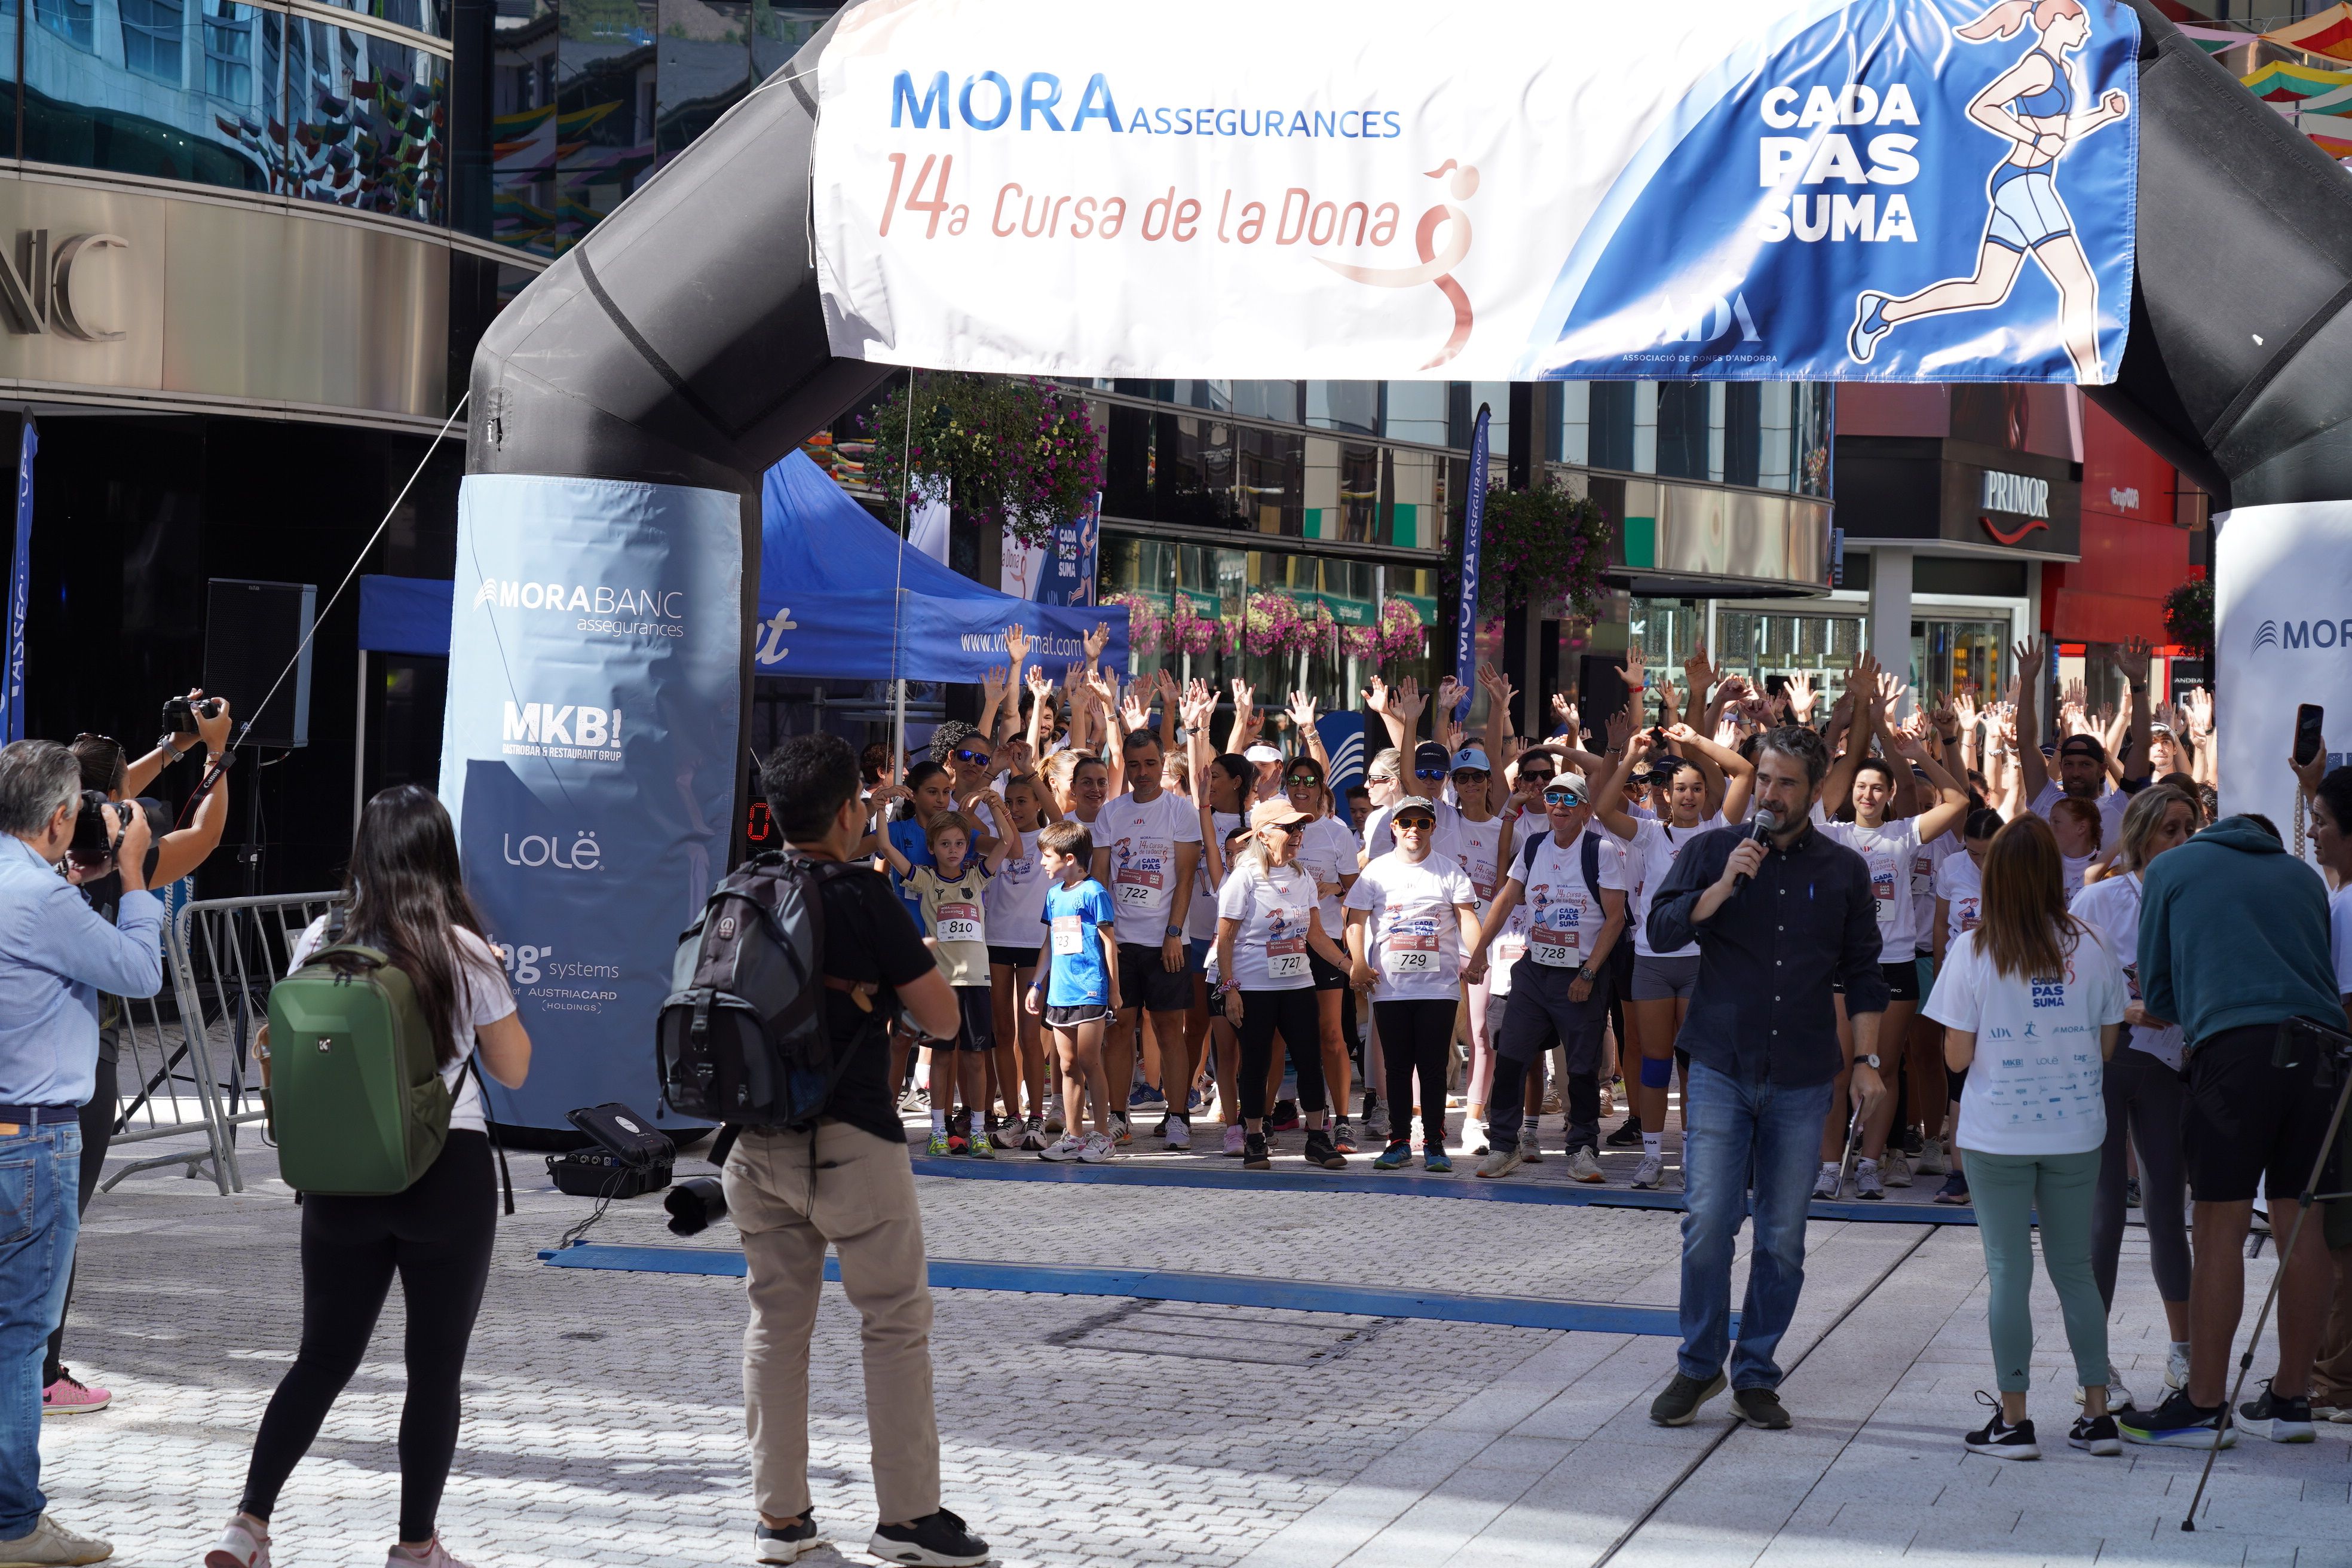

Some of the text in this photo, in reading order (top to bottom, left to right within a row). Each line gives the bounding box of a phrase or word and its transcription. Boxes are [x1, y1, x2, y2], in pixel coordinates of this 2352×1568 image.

[890, 70, 1401, 139] MORA ASSEGURANCES
[1760, 84, 1921, 129] CADA
[1760, 133, 1919, 187] PAS
[991, 182, 1127, 240] Cursa
[1140, 186, 1201, 242] de
[1217, 188, 1266, 245] la
[1276, 187, 1400, 248] Dona
[1756, 194, 1918, 243] SUMA
[1622, 353, 1676, 362] ASSOCIACIÓ
[1983, 470, 2049, 518] PRIMOR
[1059, 528, 1077, 543] CADA
[1058, 562, 1076, 578] SUMA
[577, 616, 684, 638] assegurances
[503, 700, 622, 748] MKB!
[502, 743, 622, 761] GASTROBAR & RESTAURANT GRUP
[203, 768, 220, 789] Canon
[1873, 872, 1893, 881] CADA
[1125, 887, 1148, 899] 722
[949, 921, 973, 933] 810
[1401, 954, 1426, 966] 729
[1541, 947, 1566, 959] 728
[549, 961, 620, 979] systems
[1282, 956, 1300, 971] 727
[513, 987, 617, 1000] of AUSTRIACARD
[2032, 985, 2064, 997] PAS
[2033, 997, 2065, 1008] SUMA
[2003, 1058, 2023, 1067] MKB!
